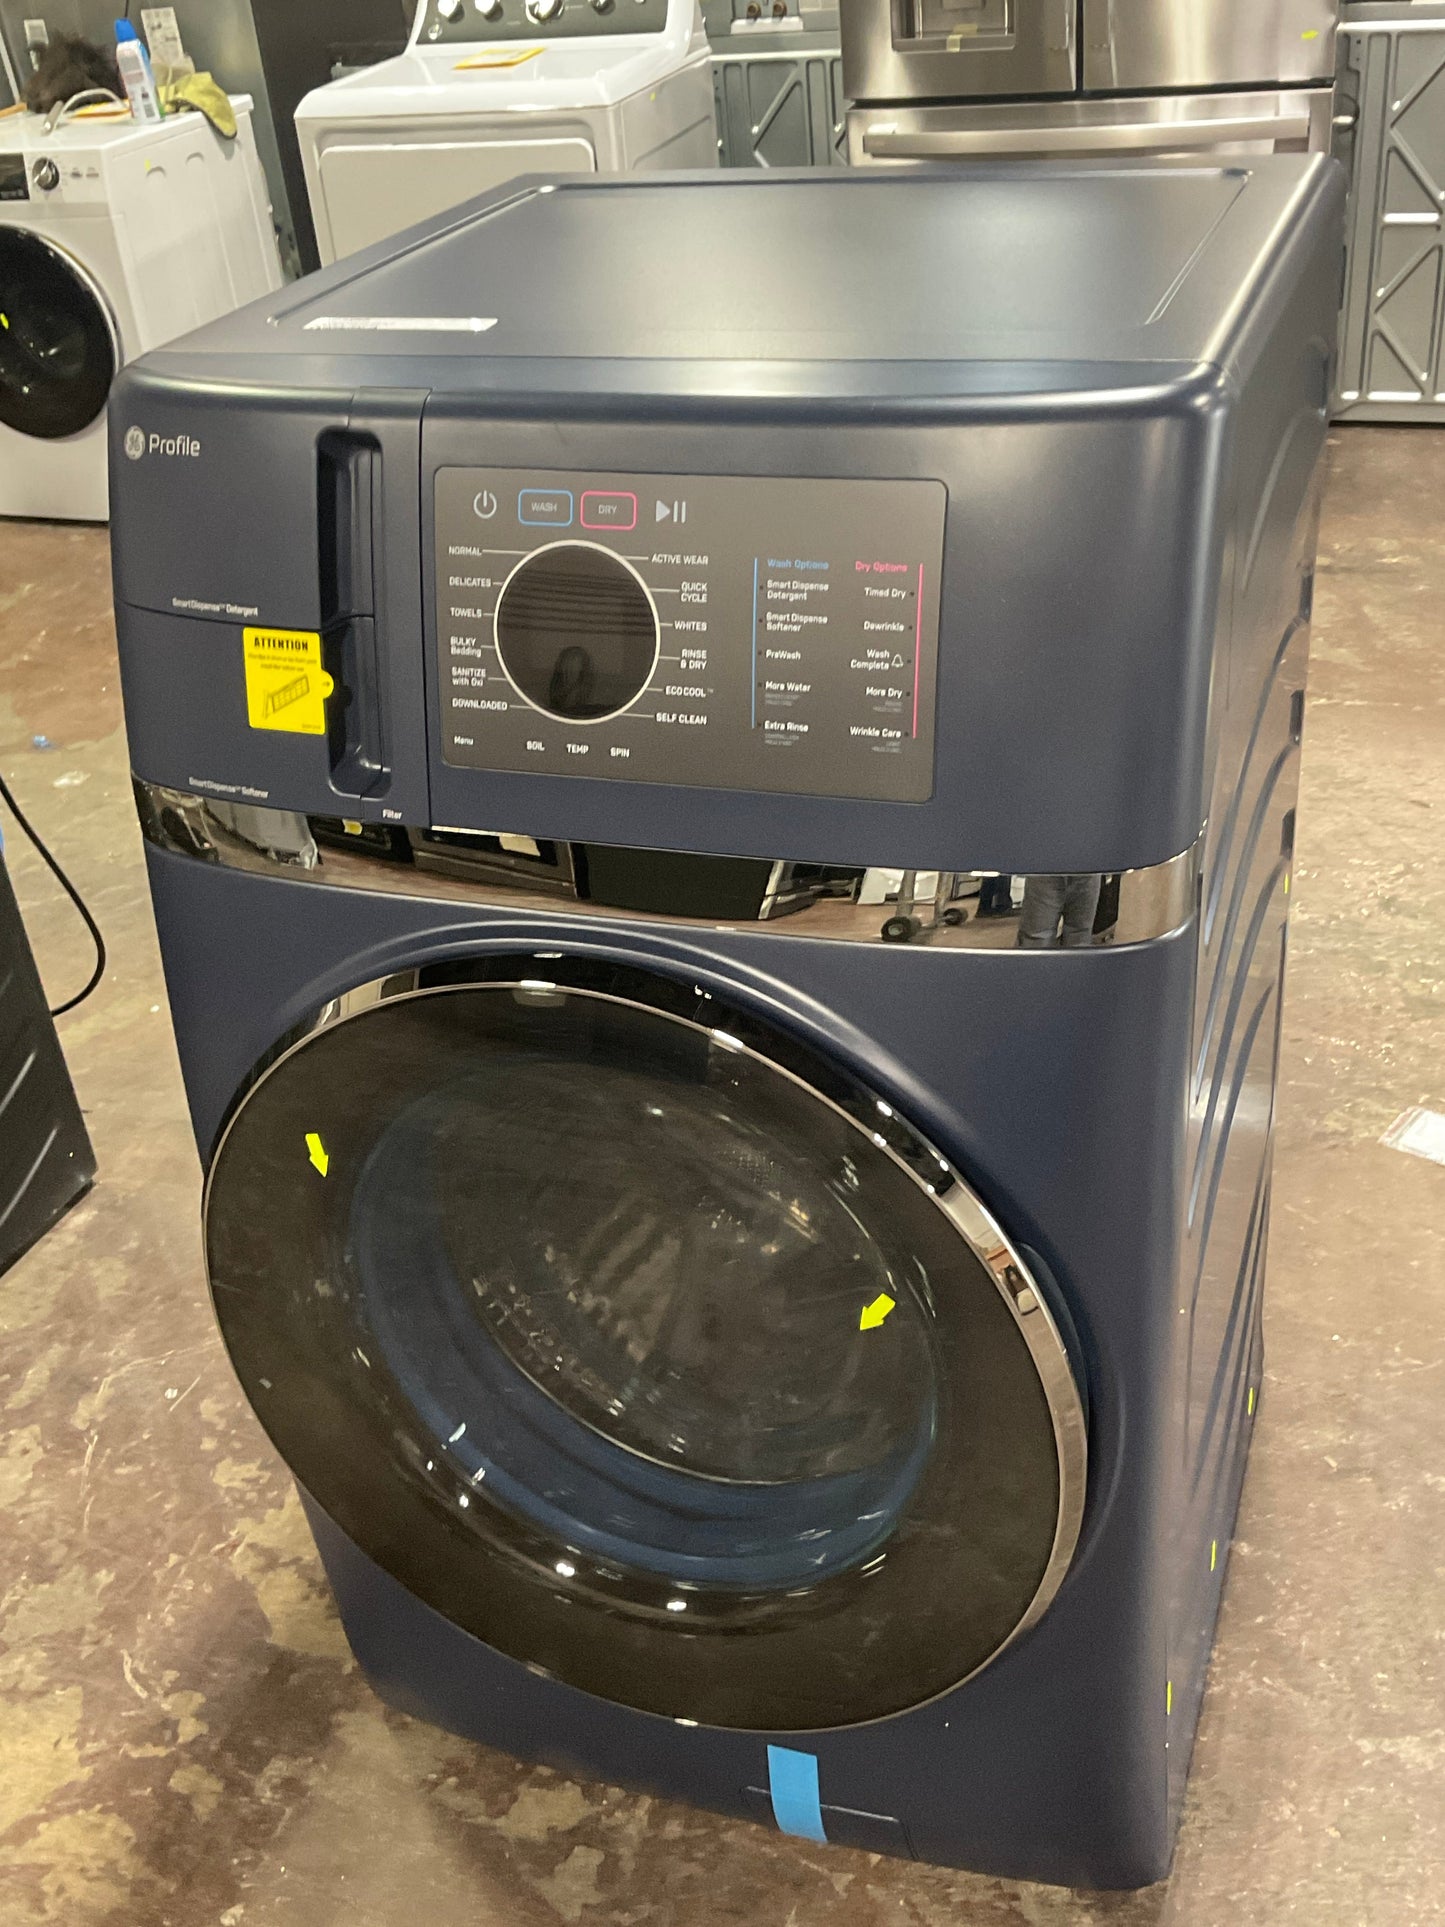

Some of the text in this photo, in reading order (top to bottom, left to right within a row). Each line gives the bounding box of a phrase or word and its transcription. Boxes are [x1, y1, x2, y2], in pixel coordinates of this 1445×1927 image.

[149, 433, 200, 457] Profile
[531, 502, 558, 513] WASH
[598, 504, 618, 515] DRY
[448, 546, 482, 557] NORMAL
[651, 553, 709, 566] ACTIVE WEAR
[767, 558, 830, 571] Wash Options
[855, 560, 908, 573] Dry Options
[449, 576, 492, 588] DELICATES
[681, 581, 708, 593] QUICK
[767, 579, 829, 592] Smart Dispense
[680, 592, 708, 603] CYCLE
[767, 590, 807, 602] Detergent
[864, 586, 906, 601] Timed Dry
[225, 603, 259, 618] Detergent
[450, 606, 482, 618] TOWELS
[766, 611, 828, 625] Smart Dispense
[674, 620, 708, 632] WHITES
[766, 622, 802, 632] Softener
[863, 620, 905, 632] Dewrinkle
[254, 637, 309, 652] ATTENTION
[450, 636, 476, 647] BULKY
[450, 646, 482, 659] Bedding
[681, 648, 708, 660] RINSE
[765, 648, 801, 660] PreWash
[866, 648, 890, 659] Wash
[688, 660, 708, 671] DRY
[850, 658, 890, 672] Complete
[451, 666, 486, 678] SANITIZE
[452, 677, 484, 688] with Oxi
[765, 680, 812, 693] More Water
[865, 686, 903, 700] More Dry
[452, 697, 509, 712] DOWNLOADED
[656, 711, 708, 726] SELF CLEAN
[764, 720, 809, 733] Extra Rinse
[849, 725, 902, 739] Wrinkle Care
[453, 735, 475, 746] Menu
[526, 740, 546, 752] SOIL
[566, 743, 590, 755] TEMP
[610, 746, 631, 759] SPIN
[241, 785, 269, 800] Softener
[382, 808, 403, 820] Filter
